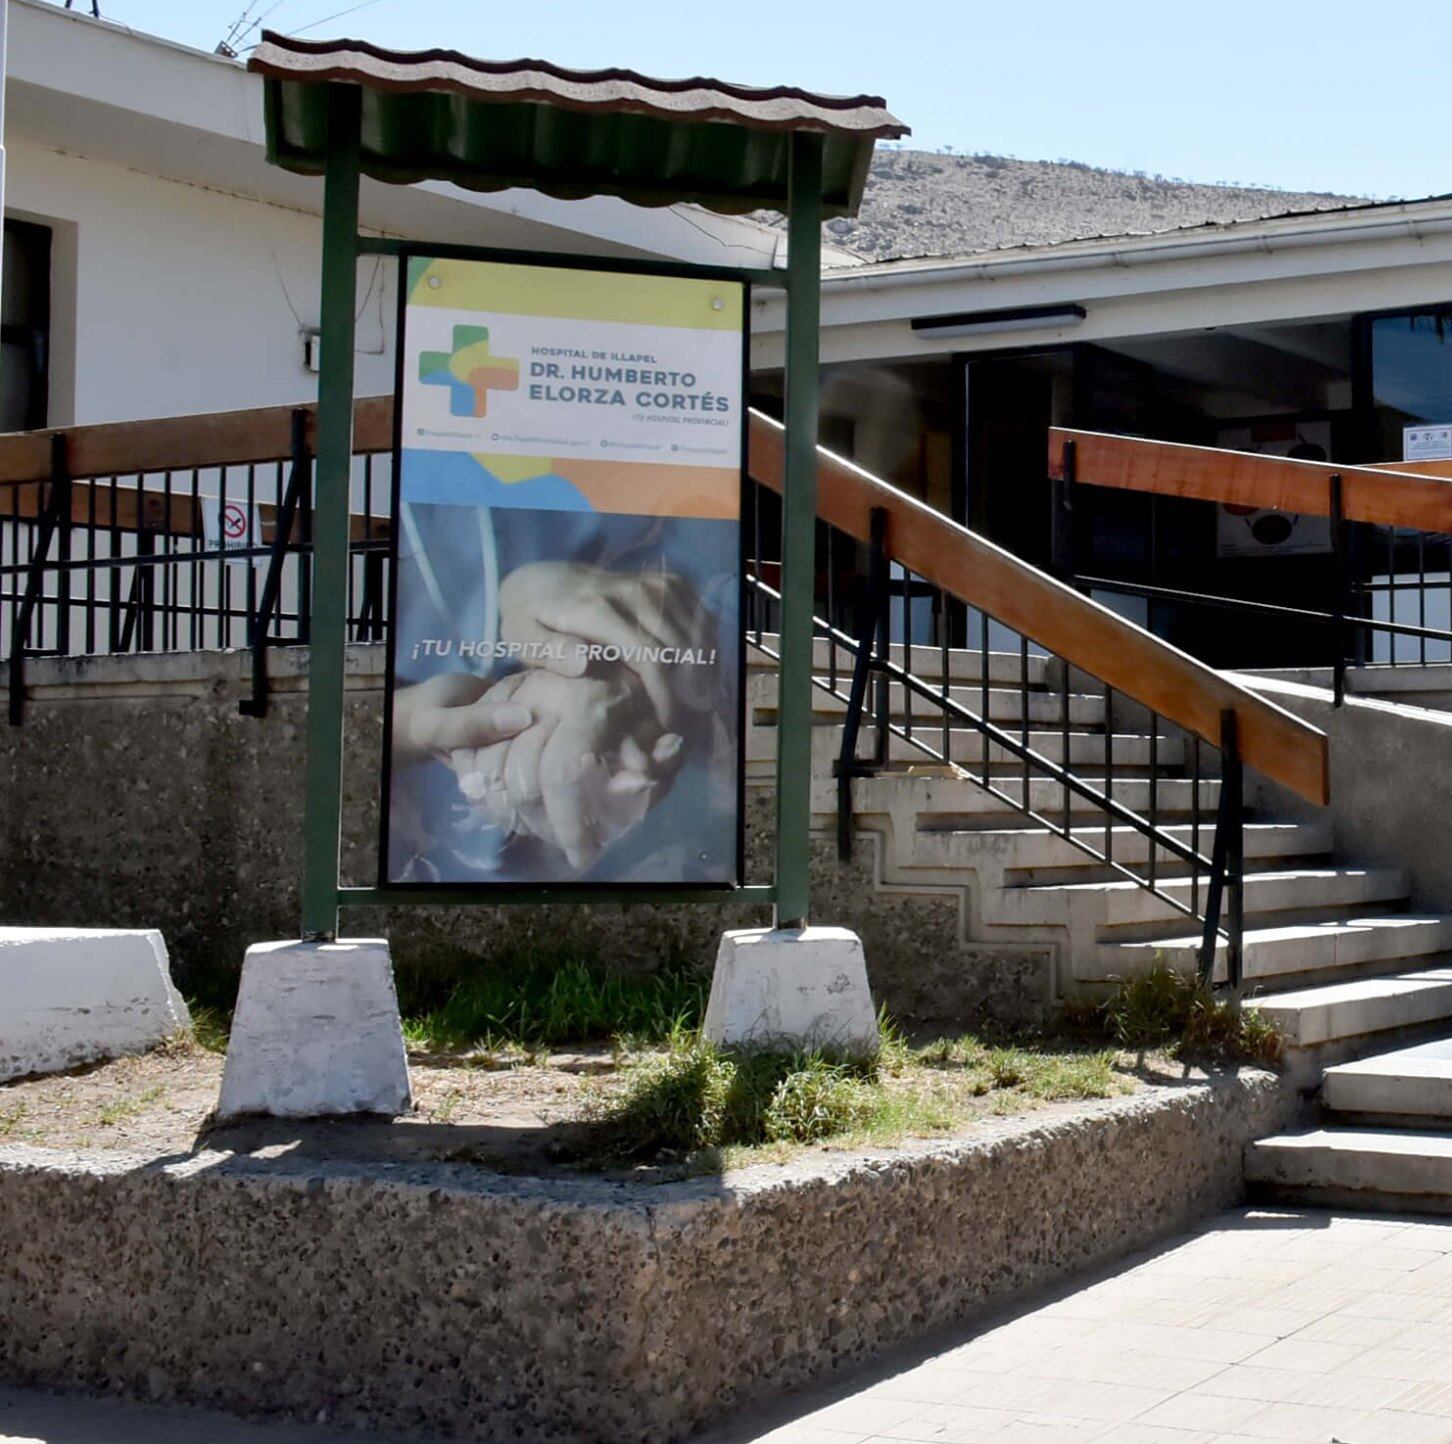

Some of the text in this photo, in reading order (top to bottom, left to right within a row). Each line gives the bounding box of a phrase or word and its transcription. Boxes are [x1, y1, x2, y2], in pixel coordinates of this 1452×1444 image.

[531, 346, 657, 364] HOSPITAL DE ILLAPEL
[530, 362, 697, 388] DR. HUMBERTO
[529, 385, 730, 413] ELORZA CORTÉS
[412, 639, 717, 665] ¡TU HOSPITAL PROVINCIAL!
